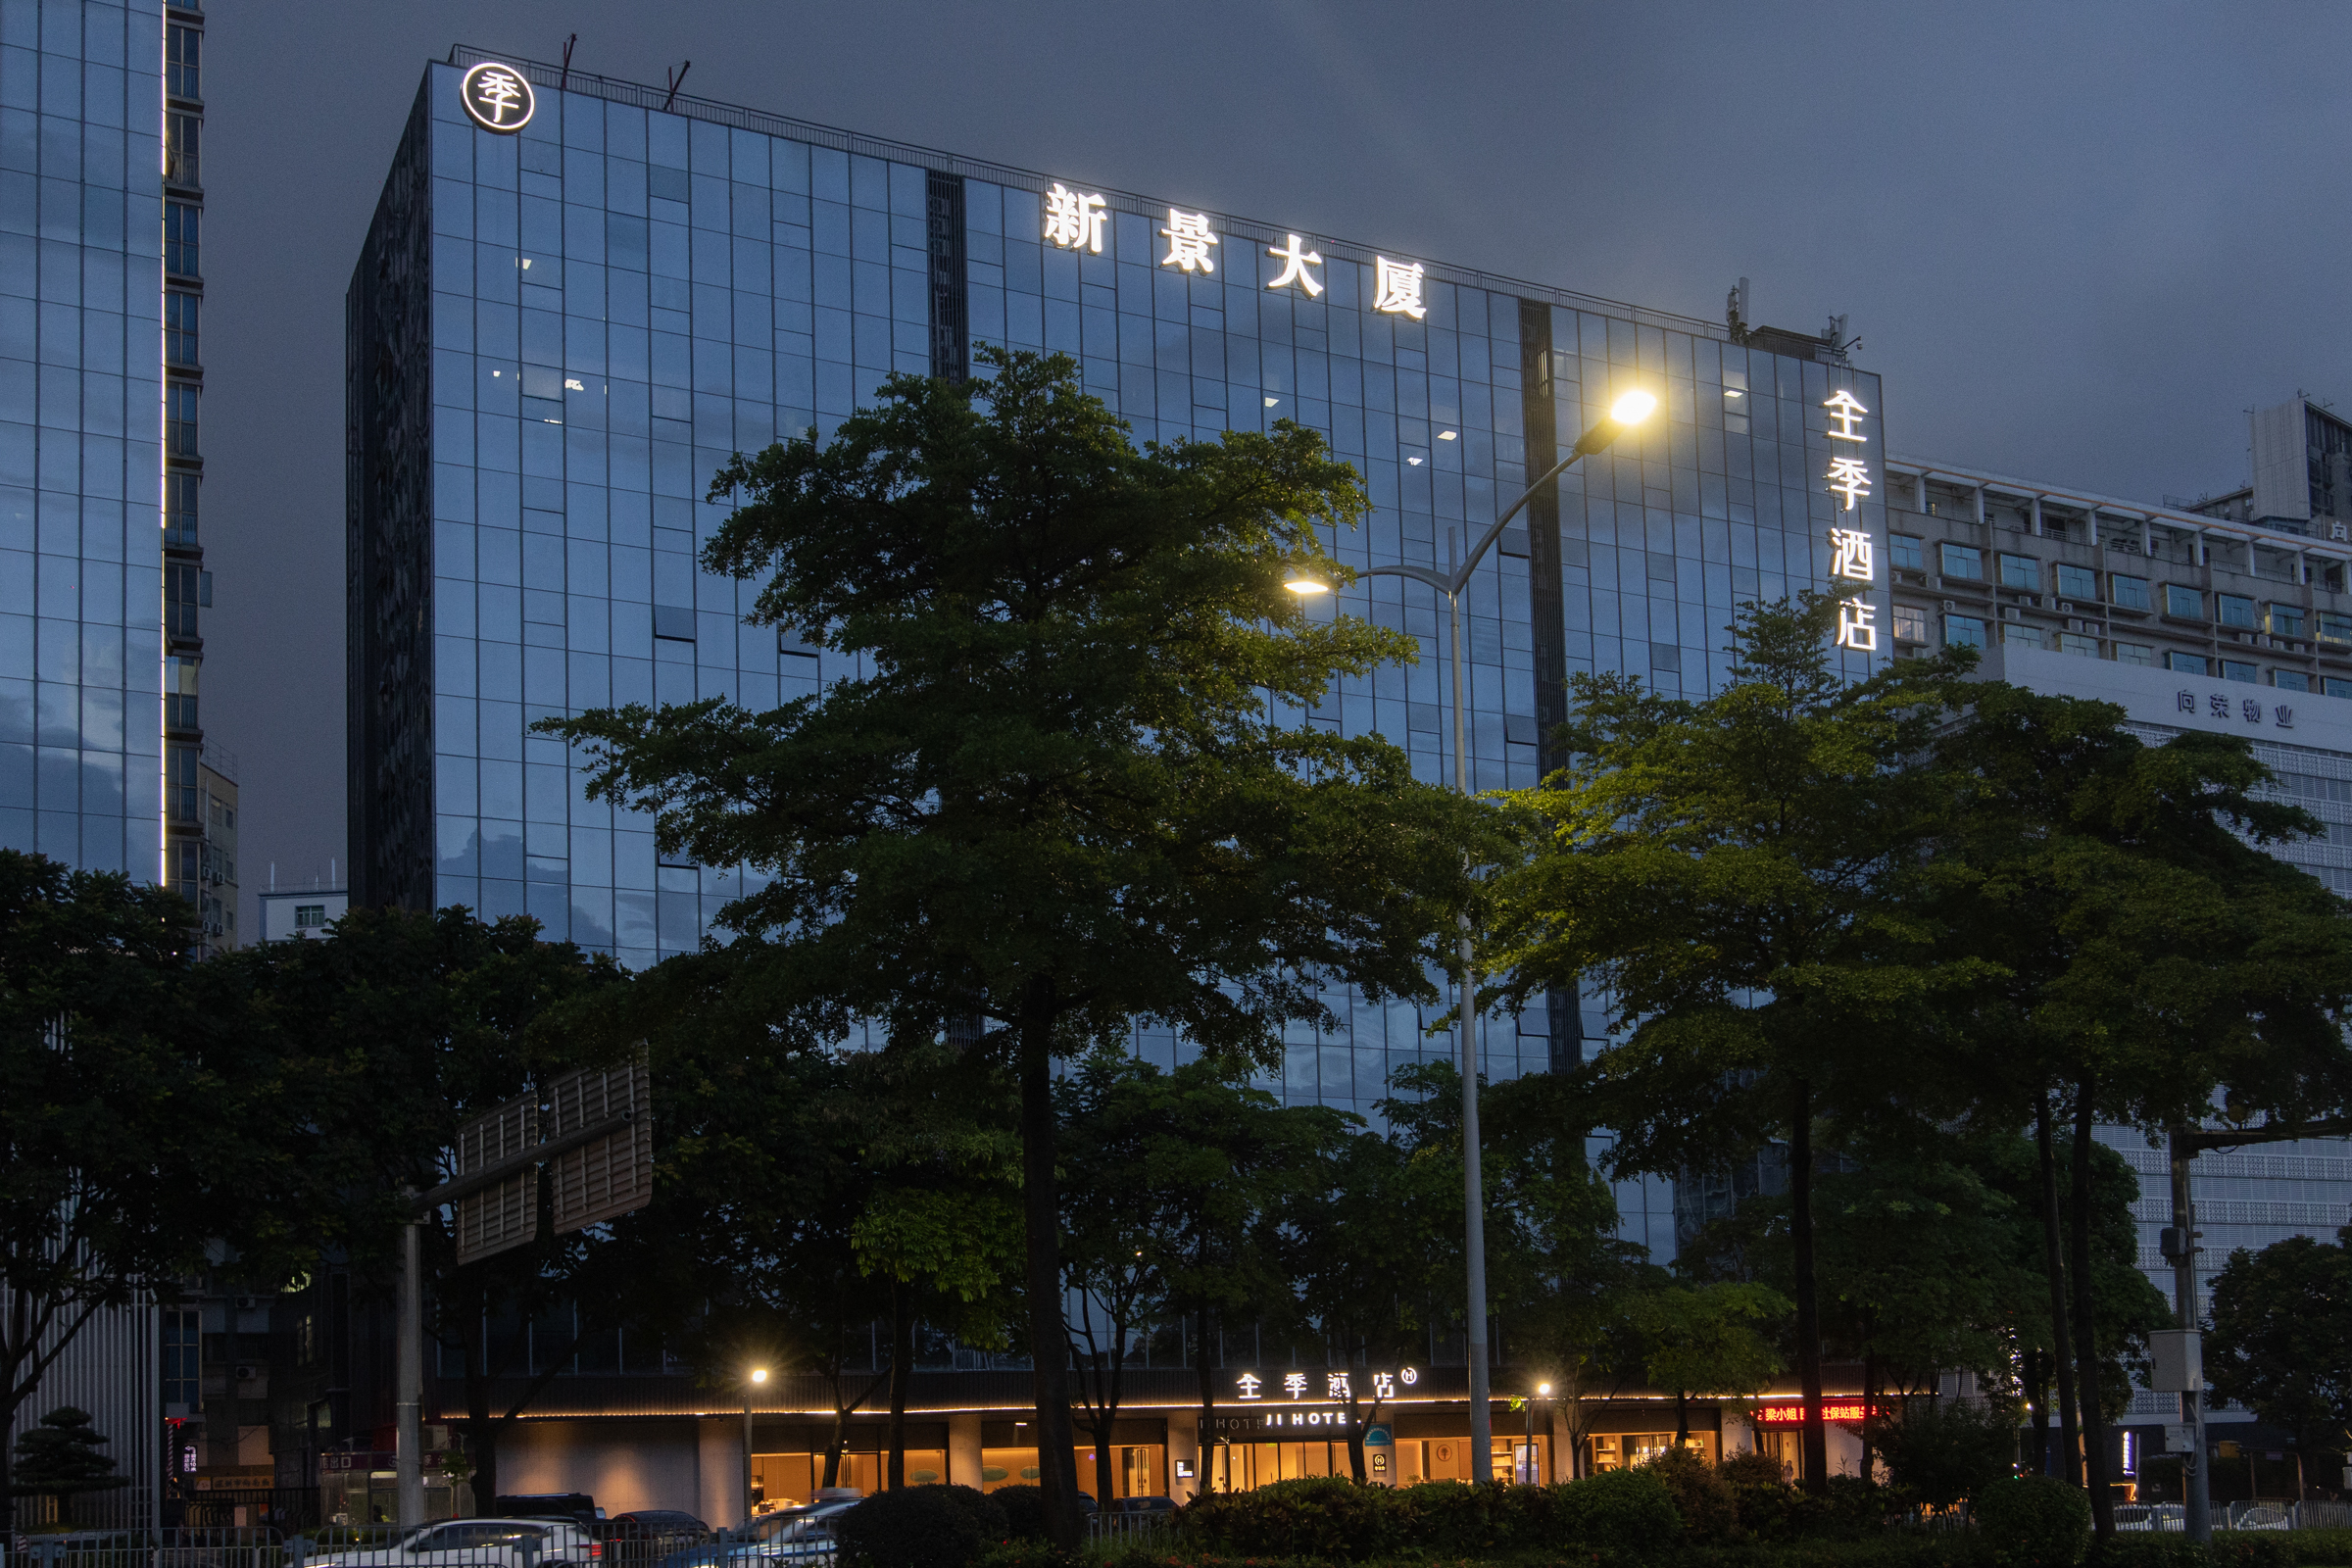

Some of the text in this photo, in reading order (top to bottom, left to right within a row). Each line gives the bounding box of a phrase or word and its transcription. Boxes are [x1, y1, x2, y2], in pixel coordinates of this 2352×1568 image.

[477, 71, 521, 123] 季
[1044, 182, 1427, 320] 新景大厦
[1824, 390, 1877, 651] 全季酒店
[2178, 689, 2295, 729] 向荣物业
[1236, 1372, 1395, 1399] 全季酒店
[1265, 1412, 1361, 1426] JI HOTE
[1765, 1407, 1797, 1421] 梁小姐
